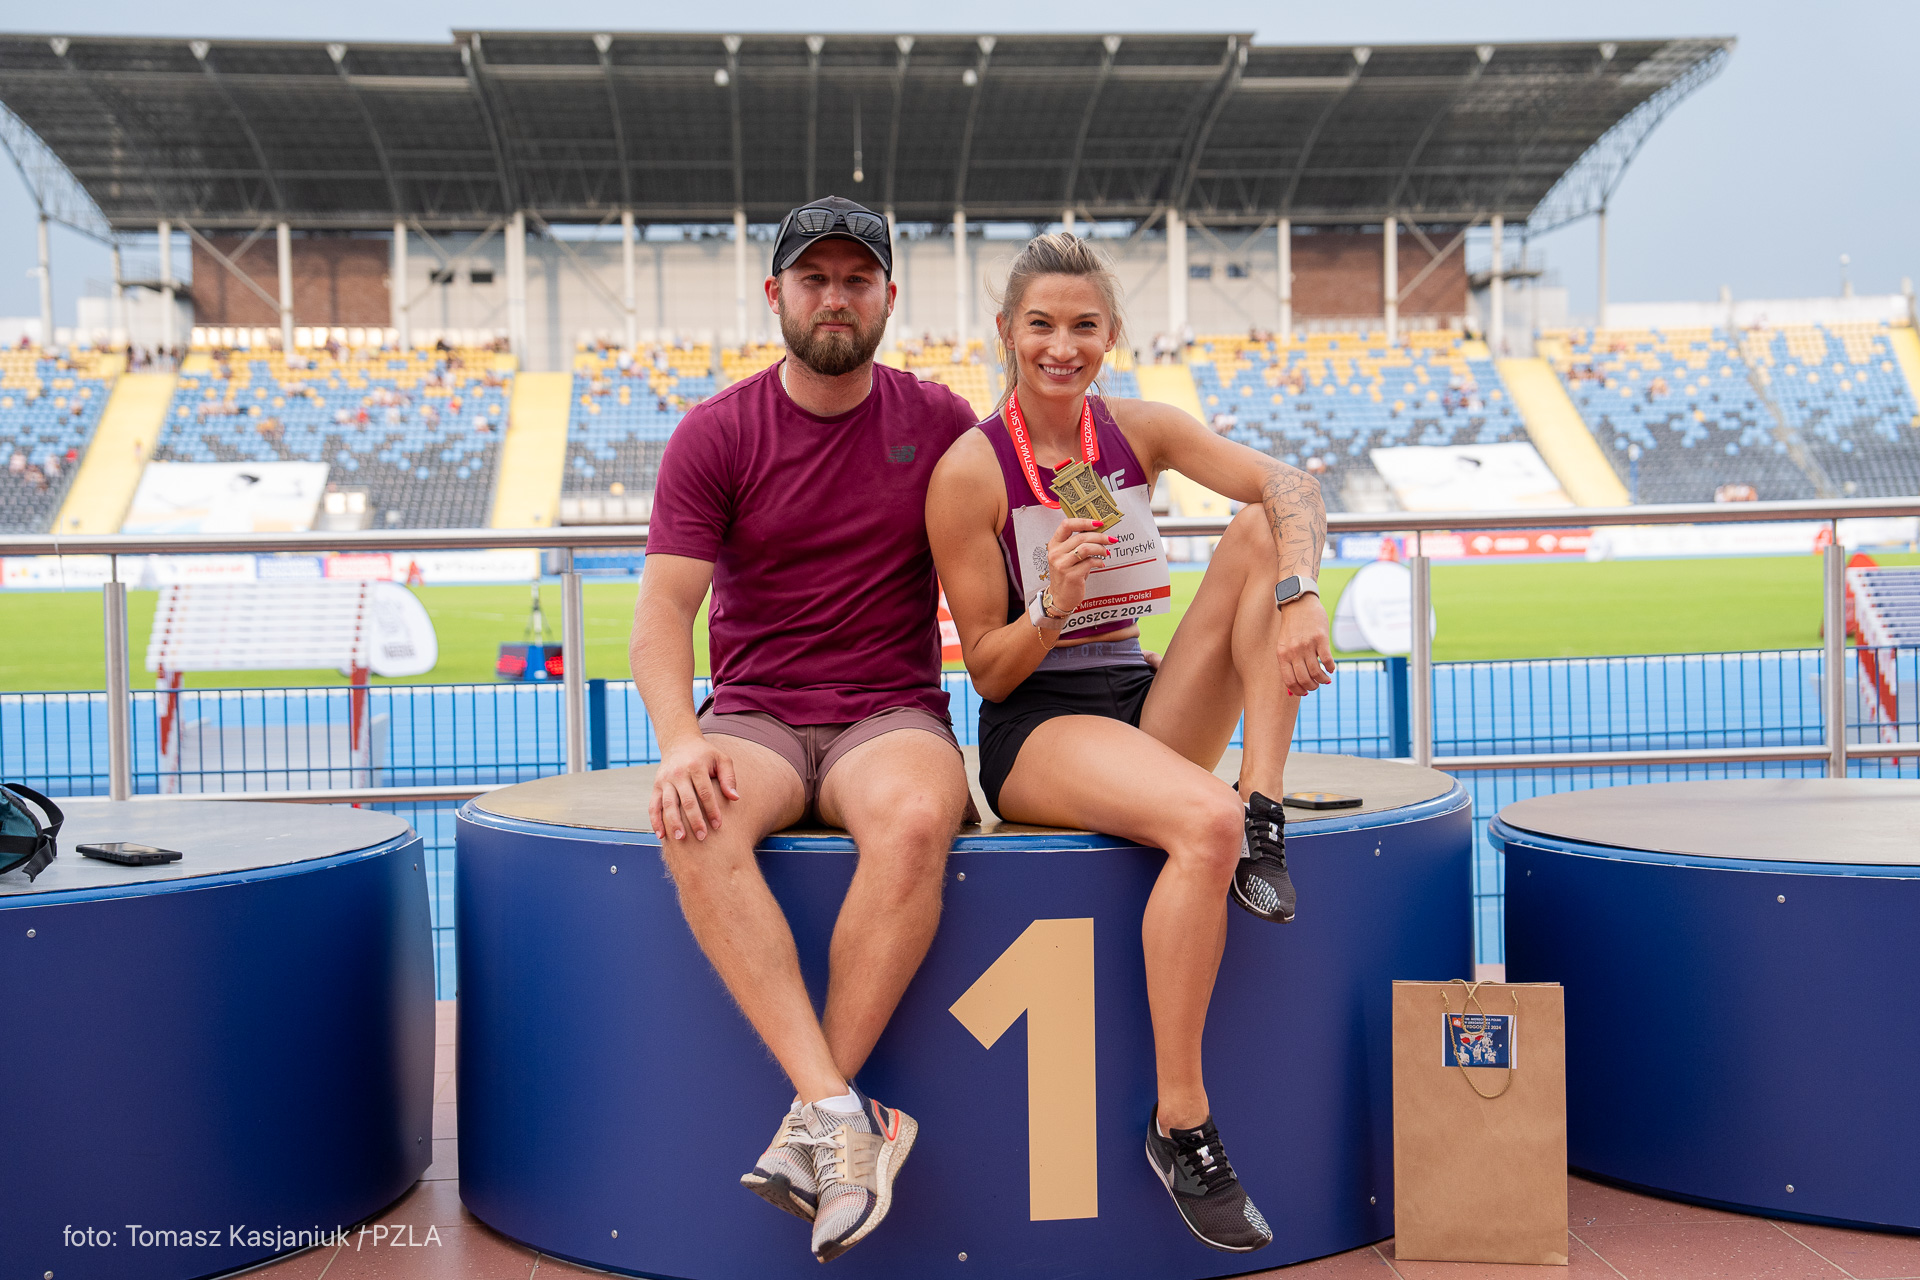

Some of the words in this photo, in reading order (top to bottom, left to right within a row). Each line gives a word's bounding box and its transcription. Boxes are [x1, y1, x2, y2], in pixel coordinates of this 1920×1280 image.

[1010, 410, 1026, 444] POLSKI
[1114, 539, 1156, 557] Turystyki
[1080, 596, 1127, 609] Mistrzostwa
[1129, 590, 1152, 601] Polski
[1121, 604, 1152, 617] 2024
[948, 918, 1098, 1221] 1
